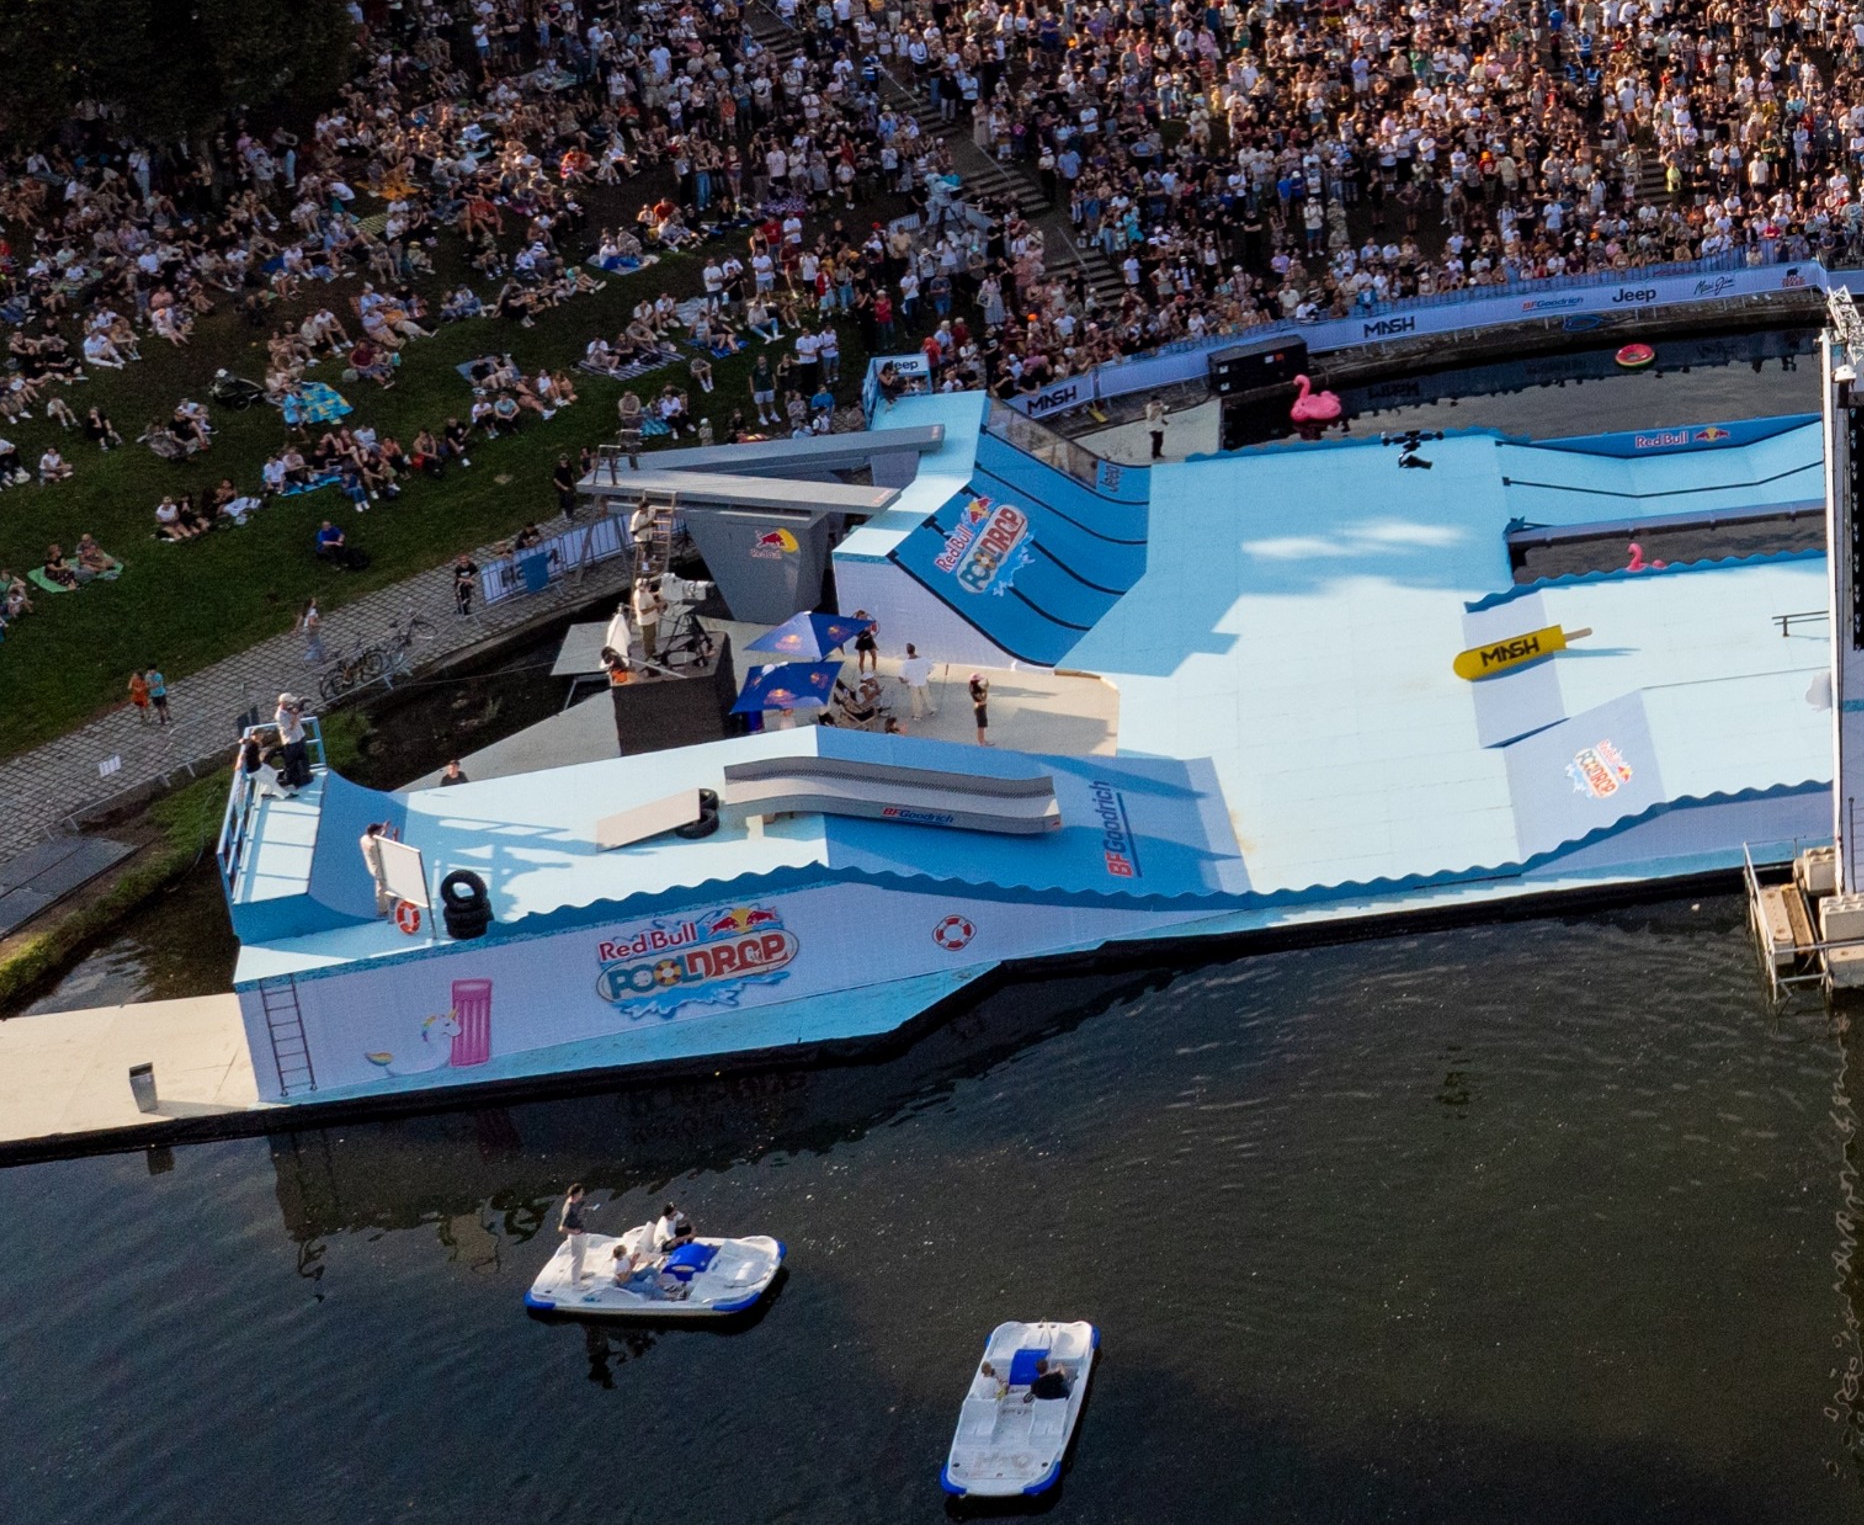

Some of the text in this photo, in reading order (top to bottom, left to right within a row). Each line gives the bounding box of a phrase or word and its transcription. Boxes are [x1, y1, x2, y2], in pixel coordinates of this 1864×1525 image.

[1522, 295, 1585, 312] BFGoodrich
[1611, 287, 1657, 304] Jeep
[1363, 316, 1415, 339] MASH
[1027, 385, 1078, 414] MASH
[1636, 431, 1688, 448] Red Bull
[934, 524, 974, 572] Red Bull
[1480, 637, 1540, 668] MASH
[883, 806, 954, 824] BFGoodrich
[1089, 780, 1133, 878] BFGoodrich
[599, 922, 698, 962] Red Bull
